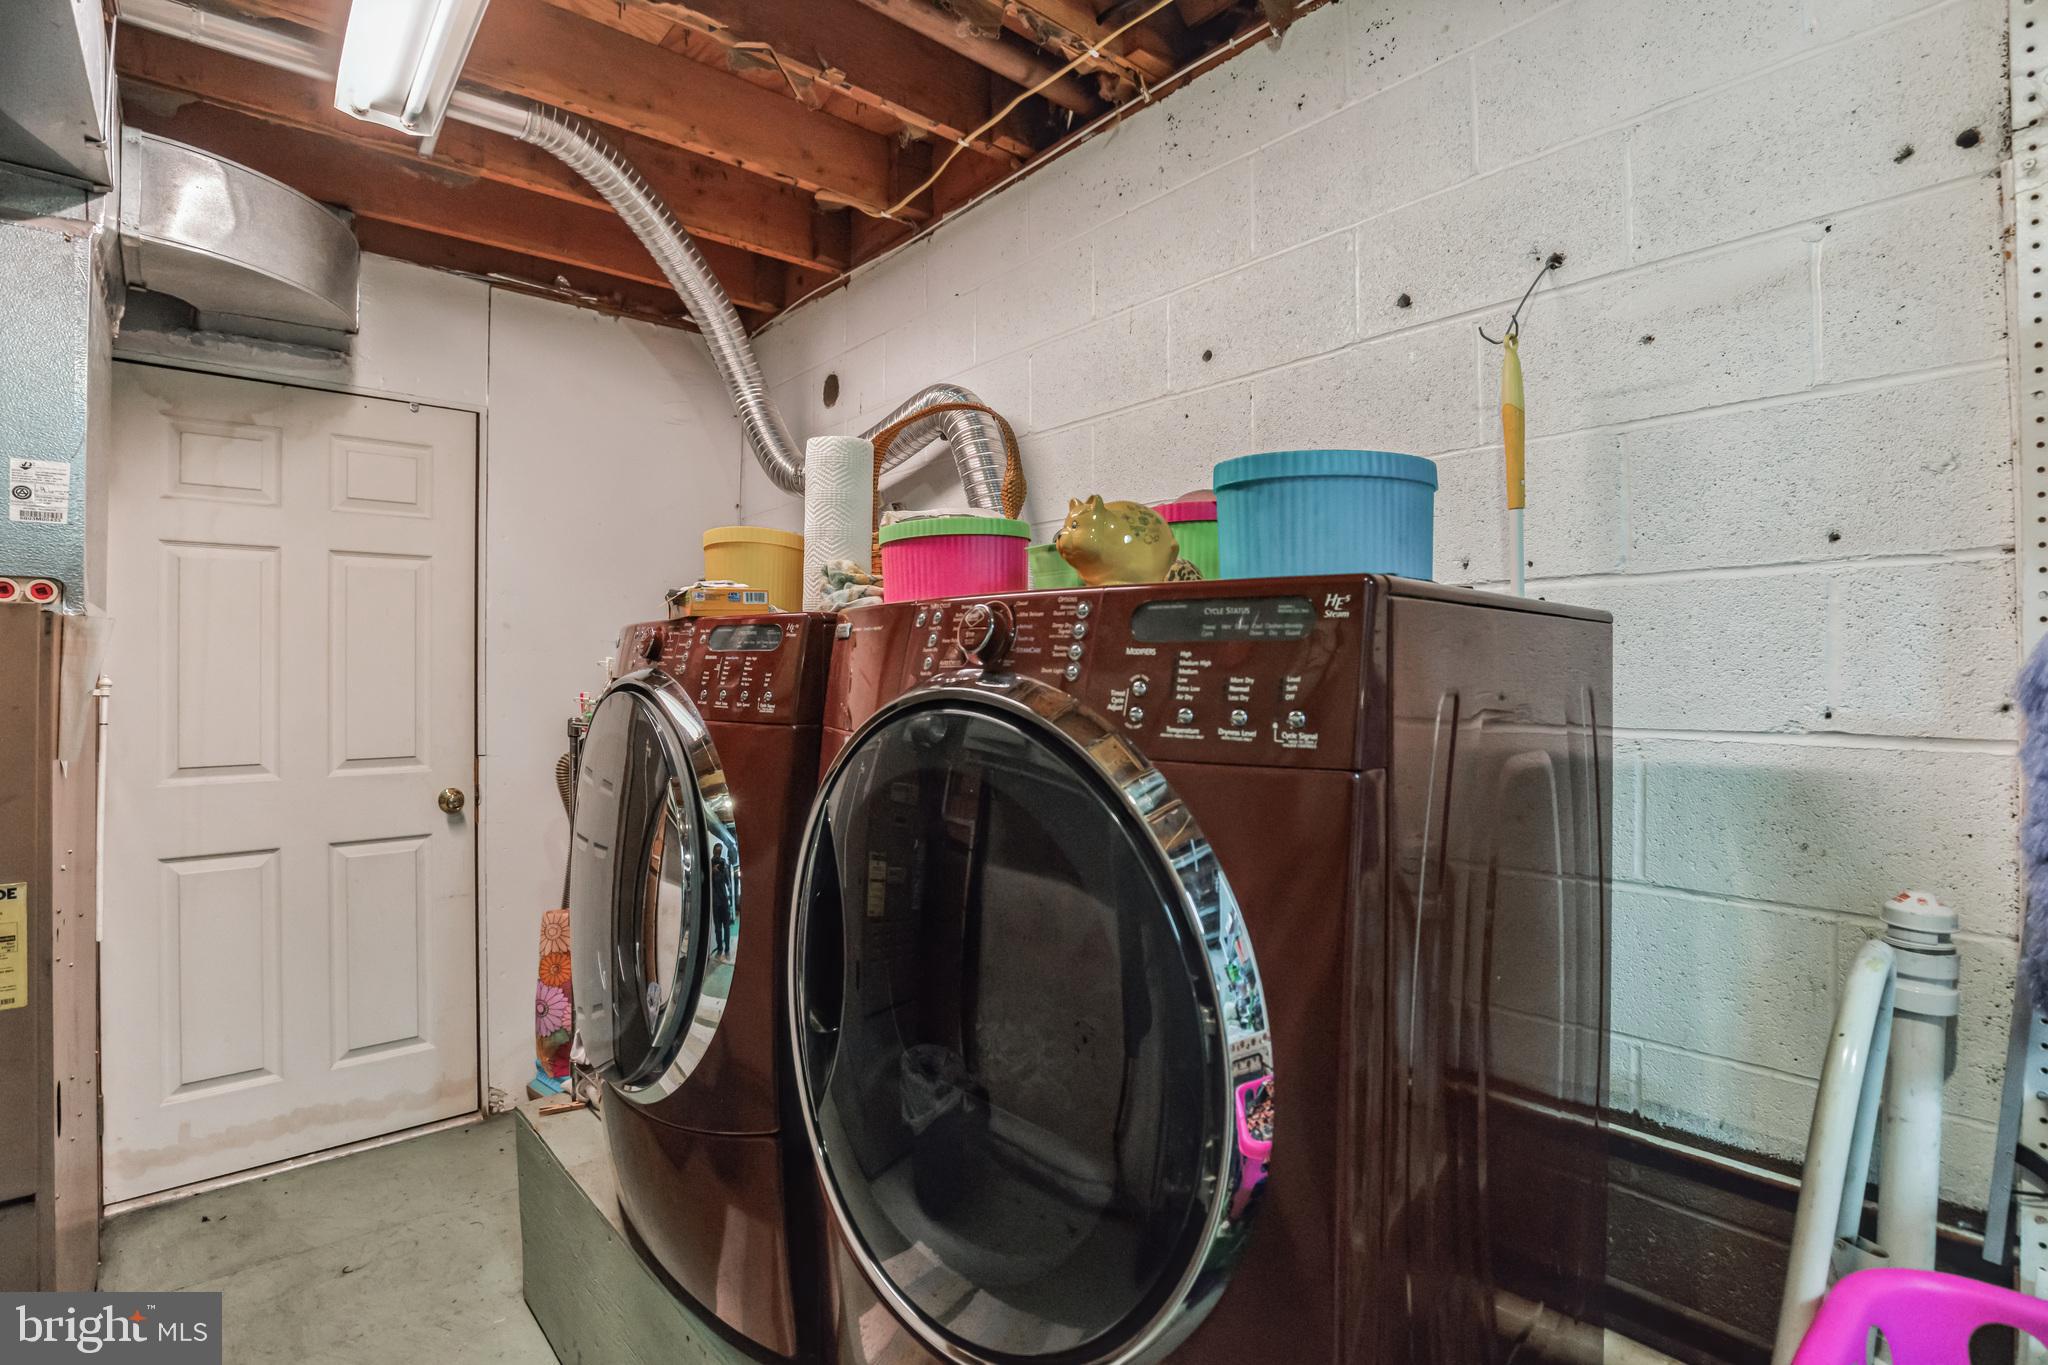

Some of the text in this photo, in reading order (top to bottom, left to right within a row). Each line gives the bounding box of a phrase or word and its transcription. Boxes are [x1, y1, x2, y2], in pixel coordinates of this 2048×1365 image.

[1323, 610, 1350, 618] Steam
[1241, 729, 1257, 737] Level
[1281, 732, 1318, 741] Cycle Signal
